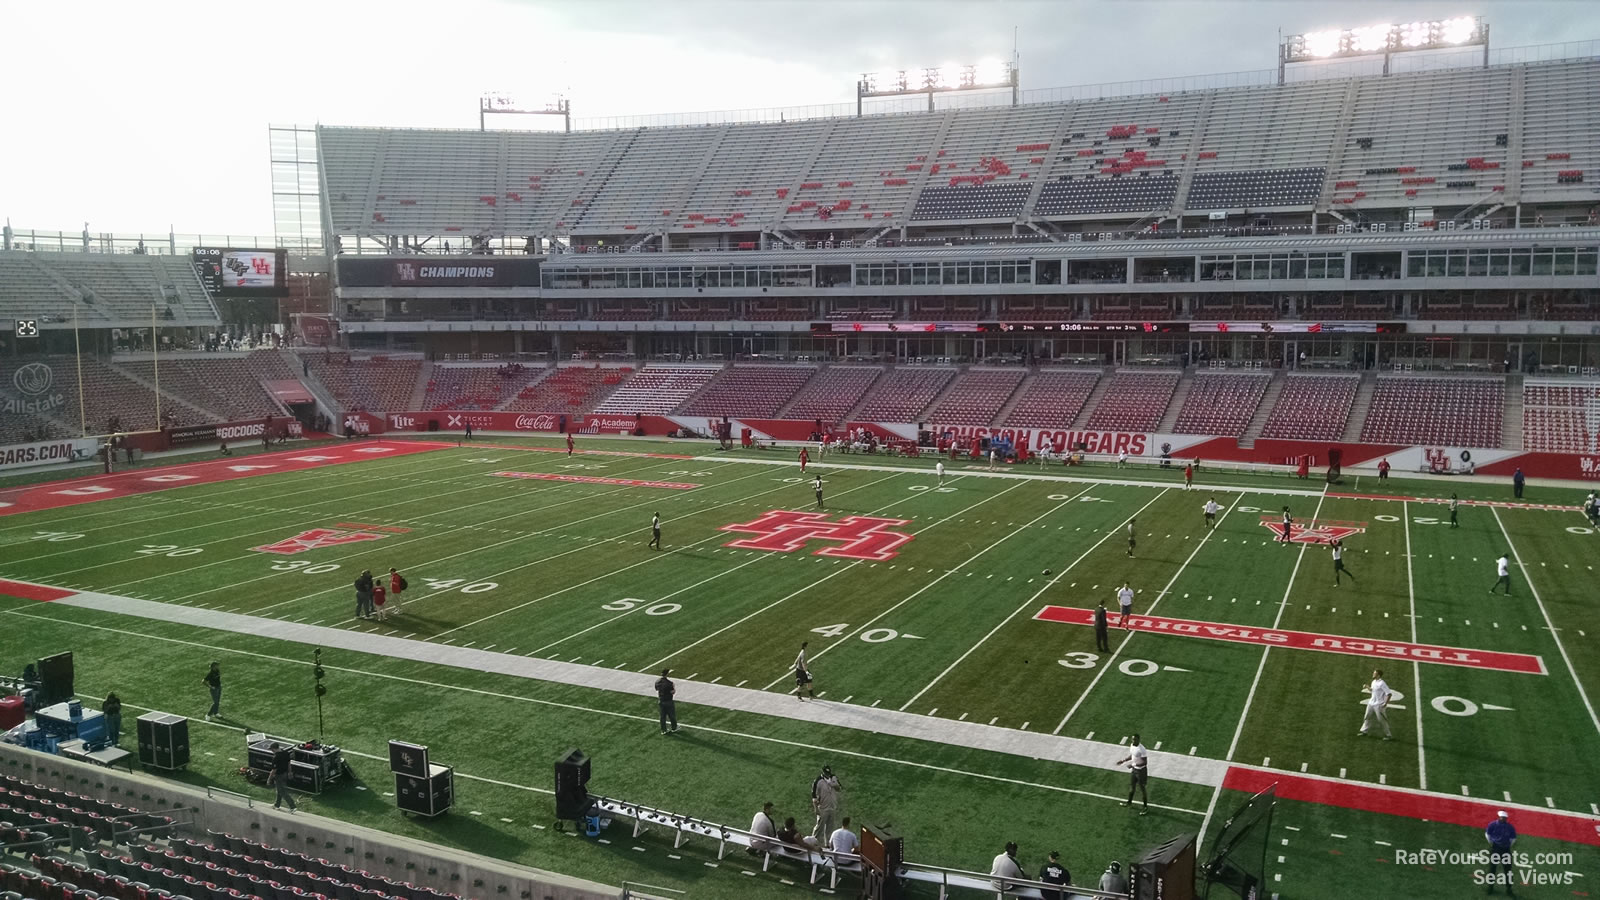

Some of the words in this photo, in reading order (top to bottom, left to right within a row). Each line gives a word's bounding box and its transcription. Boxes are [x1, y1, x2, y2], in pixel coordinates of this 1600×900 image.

[251, 257, 271, 275] UH
[420, 266, 494, 278] CHAMPIONS
[17, 321, 38, 336] 25
[2, 393, 64, 414] Allstate
[391, 415, 415, 429] Lite
[601, 418, 637, 431] Academy
[216, 423, 265, 439] #GOCOOGS
[1036, 429, 1147, 455] COUGARS
[271, 560, 341, 574] 30
[425, 578, 499, 594] 40
[602, 598, 682, 616] 50
[811, 623, 898, 644] 40
[1310, 638, 1480, 663] TDECU
[1058, 652, 1160, 676] 30
